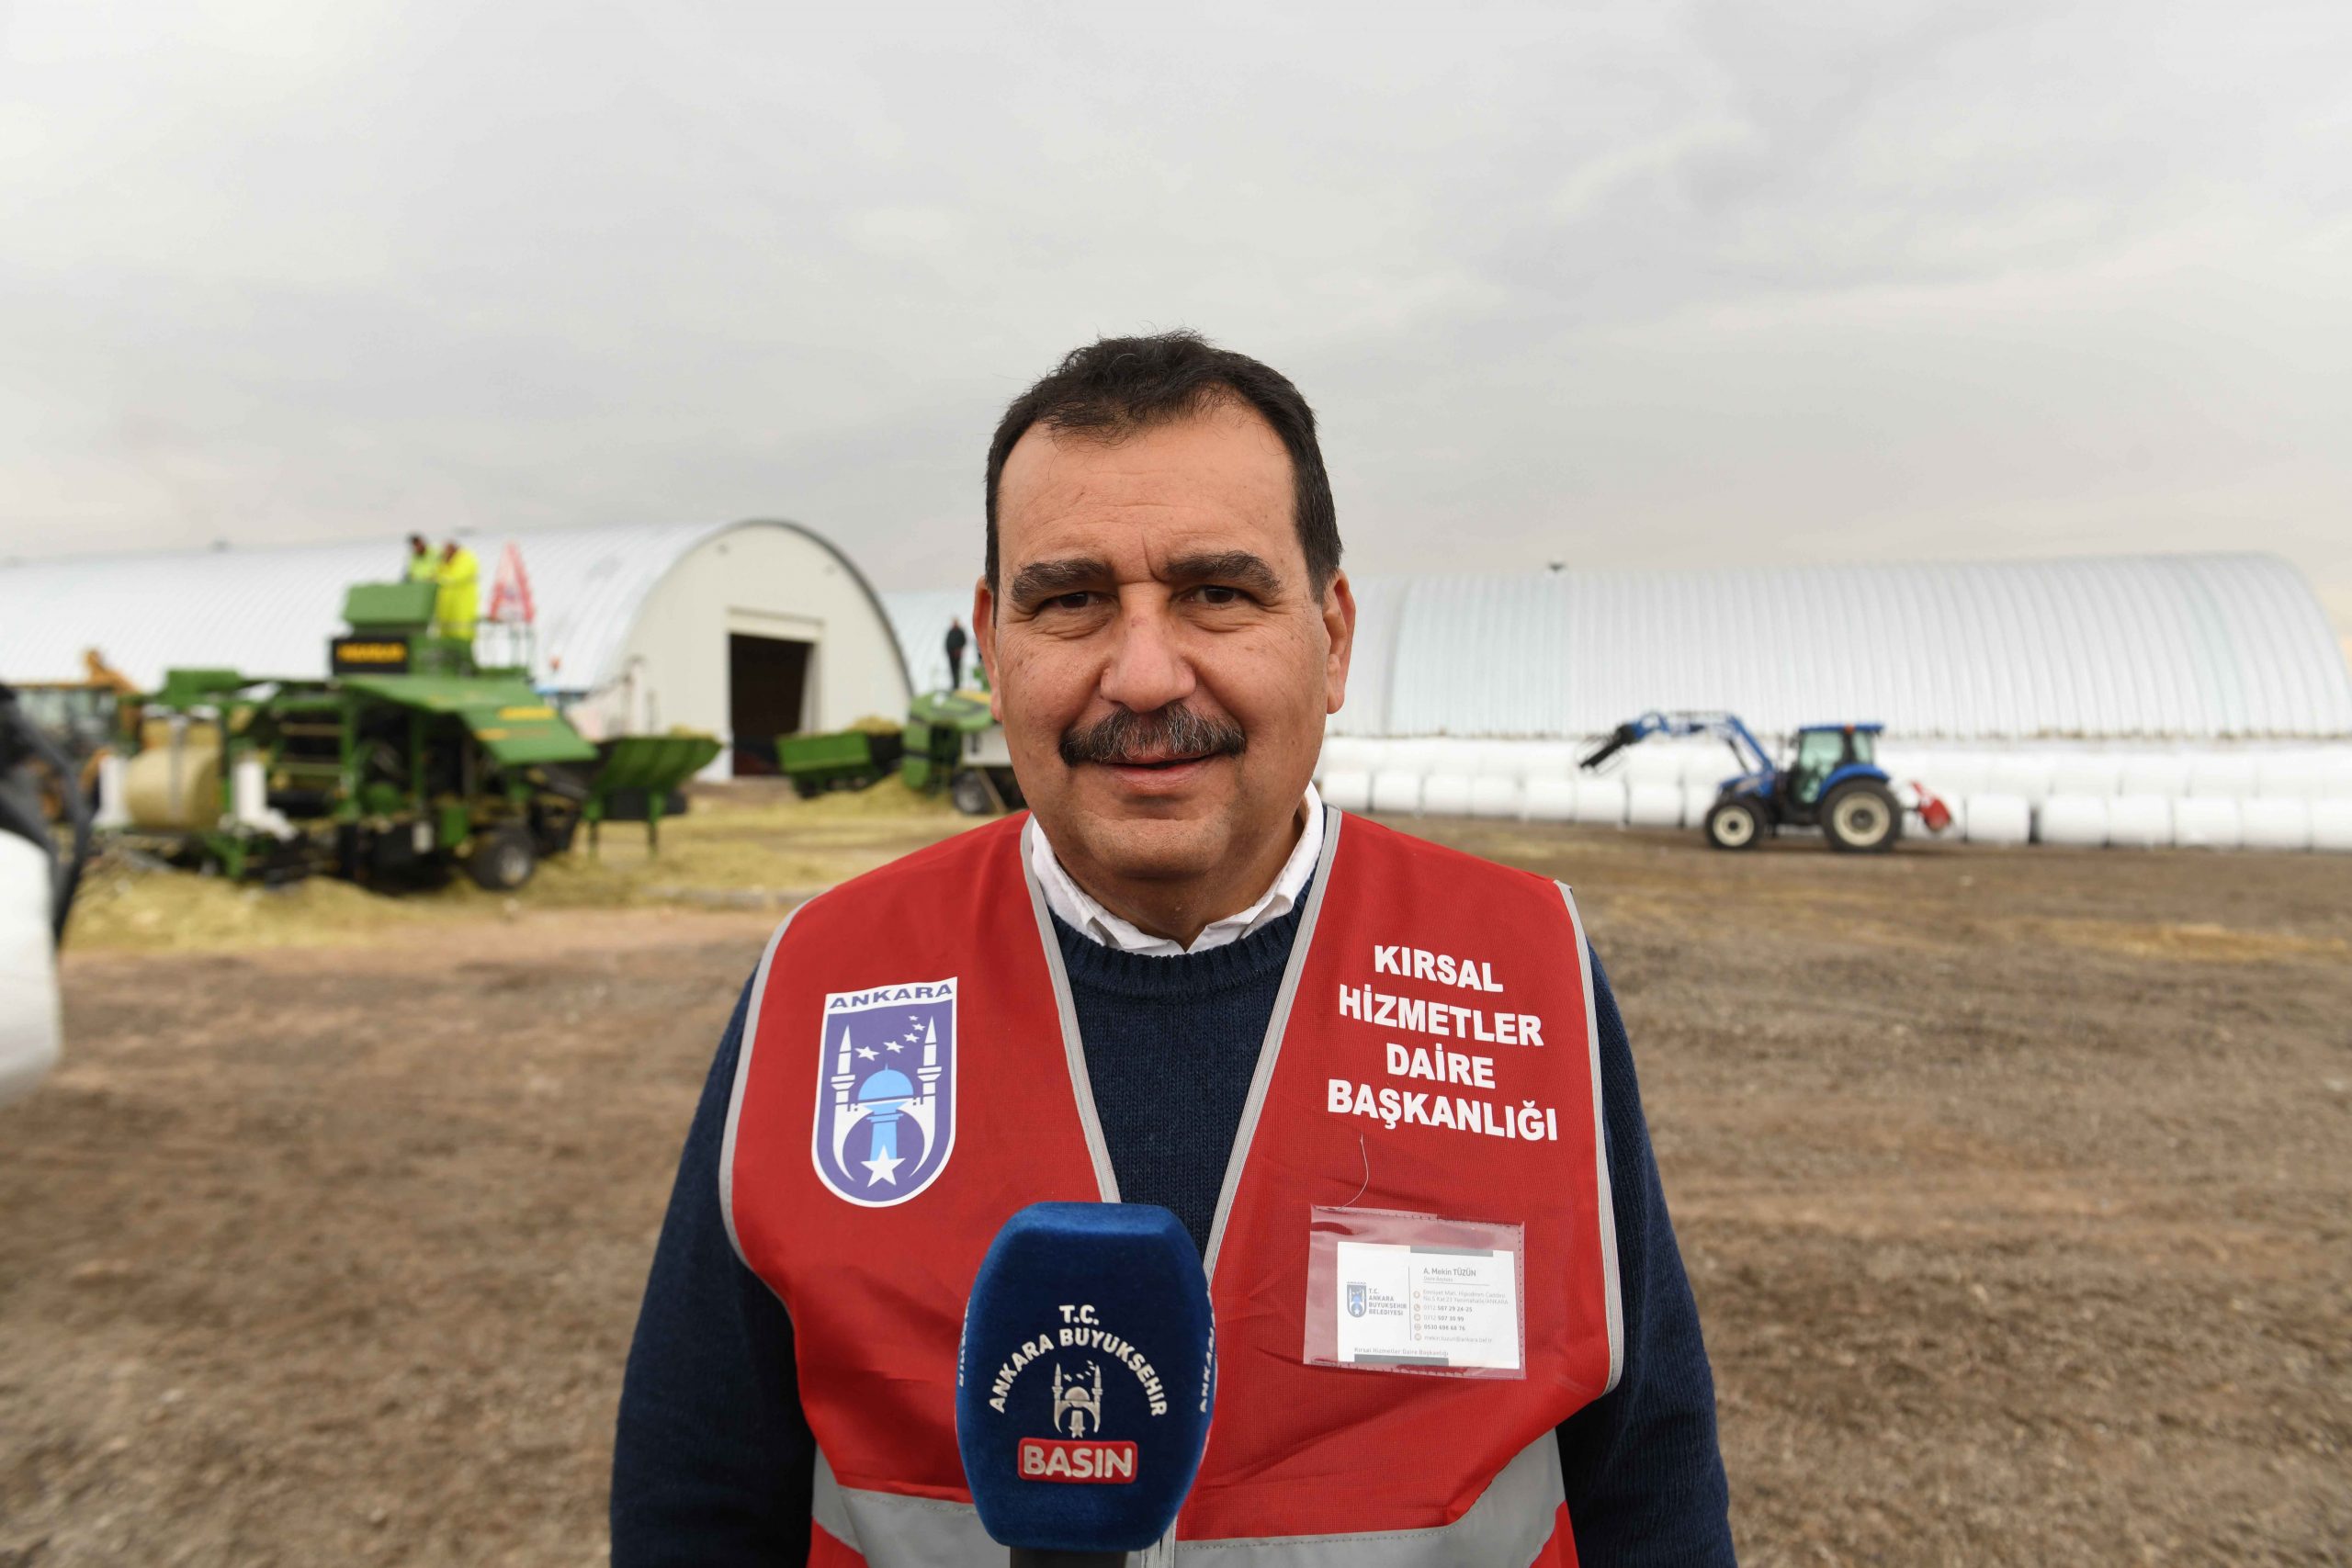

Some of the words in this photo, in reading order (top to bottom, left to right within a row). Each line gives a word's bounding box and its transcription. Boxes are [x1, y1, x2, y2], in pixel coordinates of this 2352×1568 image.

[1374, 945, 1503, 992] KIRSAL
[830, 984, 952, 1009] ANKARA
[1340, 984, 1544, 1046] HİZMETLER
[1386, 1043, 1495, 1089] DAİRE
[1328, 1078, 1557, 1141] BAŞKANLIĞI
[1431, 1268, 1453, 1276] Mekin
[1453, 1267, 1476, 1277] TÜZÜN
[1059, 1304, 1099, 1325] T.C.
[989, 1334, 1054, 1414] ANKARA
[1023, 1445, 1133, 1478] BASIN
